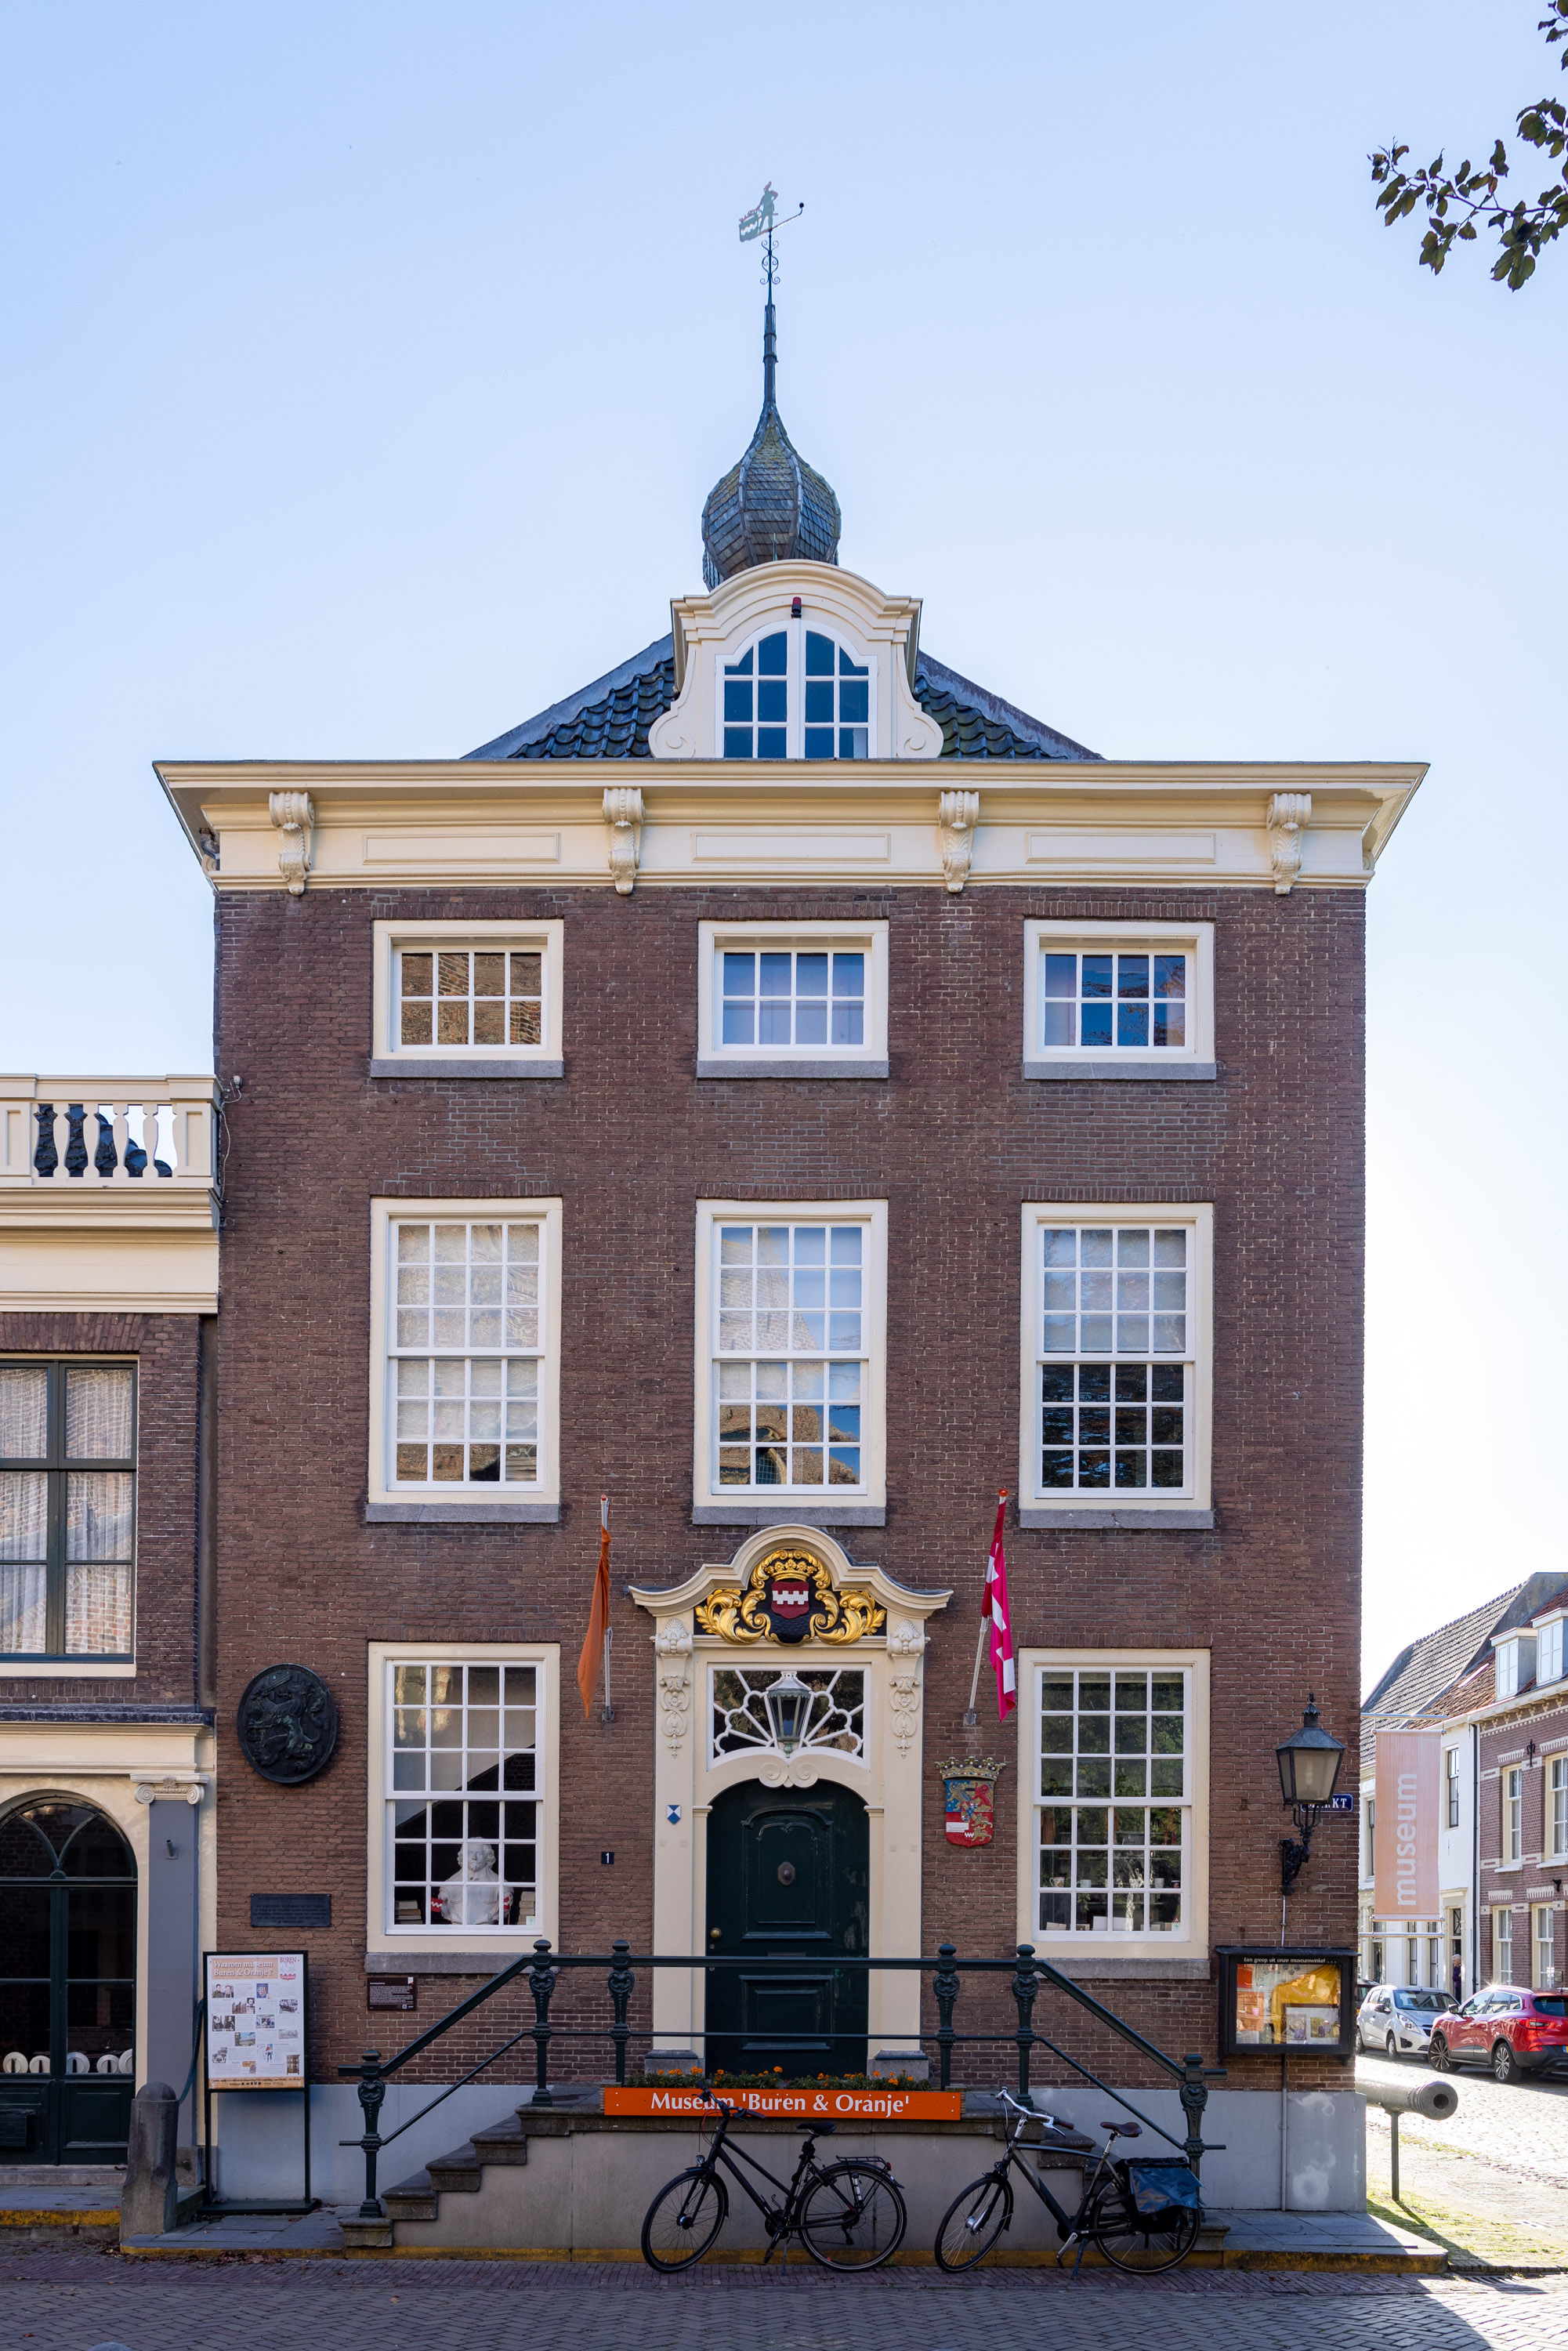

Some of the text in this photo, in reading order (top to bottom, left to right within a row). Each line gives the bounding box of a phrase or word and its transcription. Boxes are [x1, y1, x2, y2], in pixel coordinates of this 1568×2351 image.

[1397, 1773, 1417, 1906] museum
[651, 2092, 909, 2117] Museum 'Buren & Oranje'
